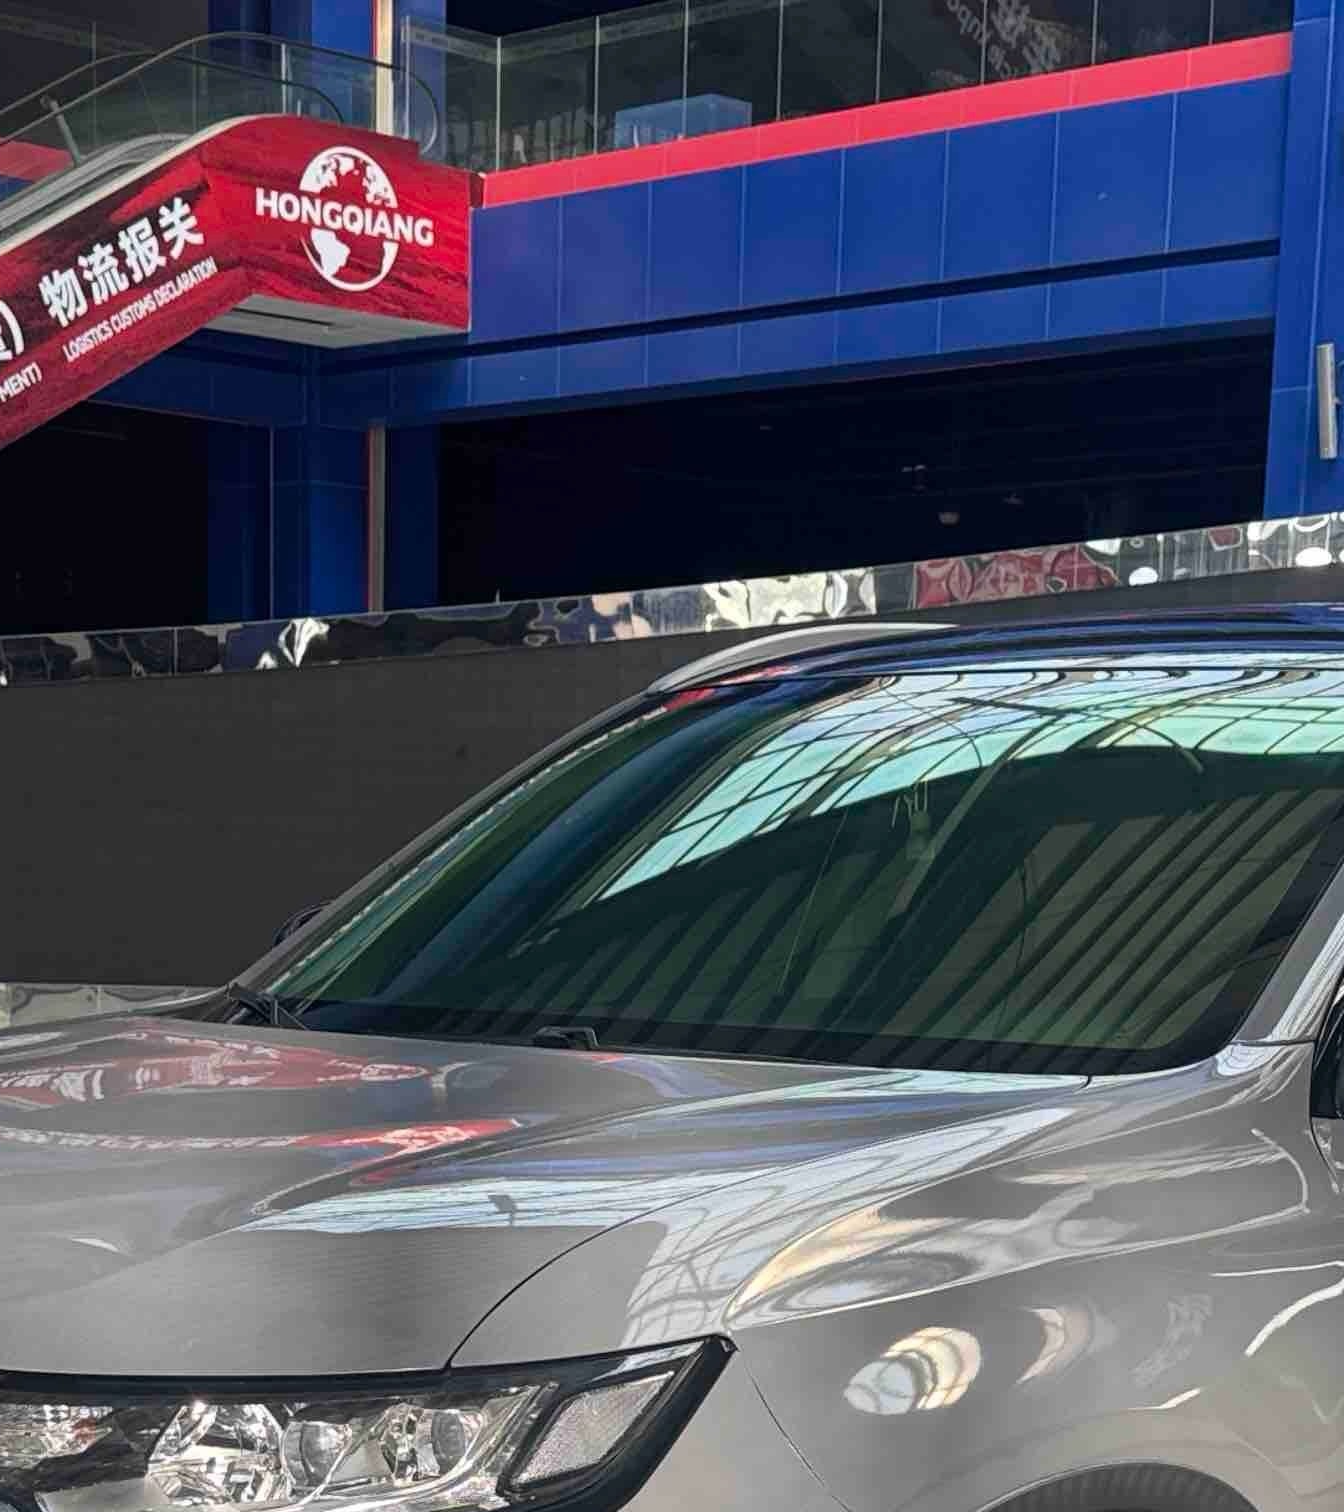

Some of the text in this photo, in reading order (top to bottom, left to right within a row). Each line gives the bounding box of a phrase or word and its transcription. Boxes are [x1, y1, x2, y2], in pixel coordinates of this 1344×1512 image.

[38, 196, 205, 328] 物流报关
[255, 186, 434, 247] HONGQIANG
[62, 256, 217, 363] LOGISTICS CUSTOMS DECLARATION
